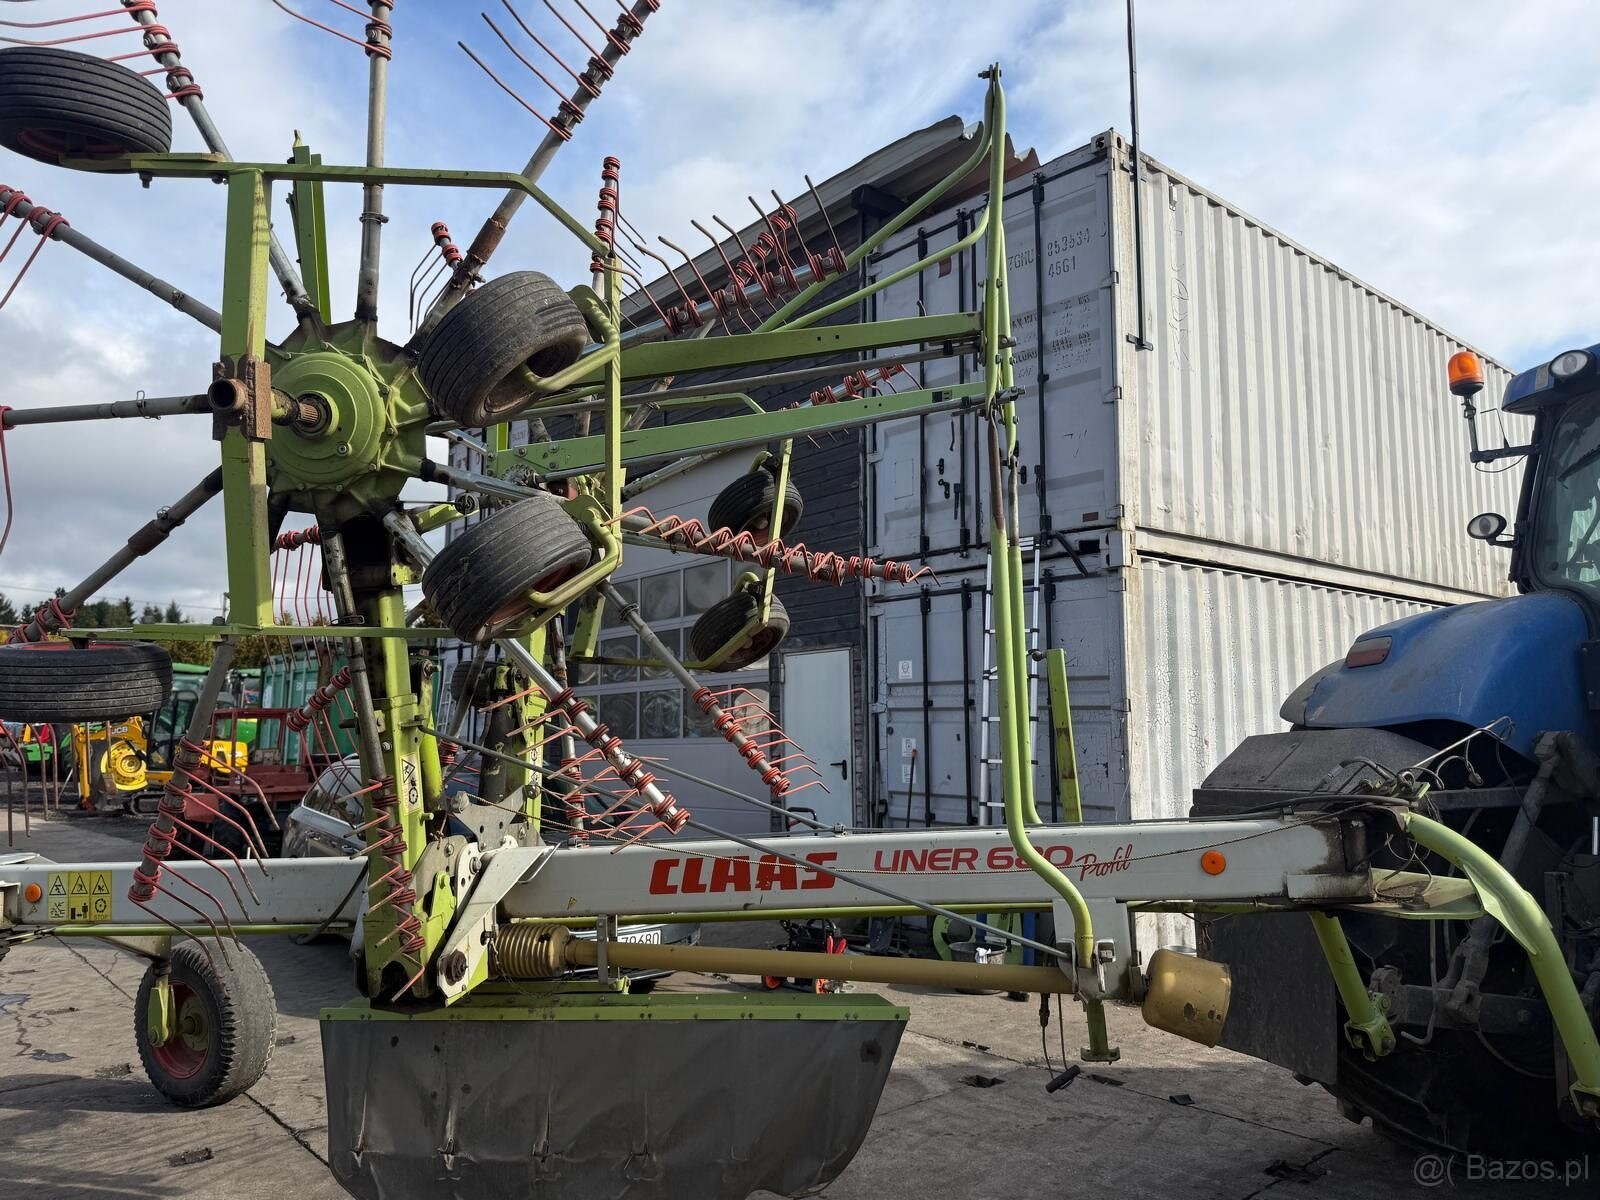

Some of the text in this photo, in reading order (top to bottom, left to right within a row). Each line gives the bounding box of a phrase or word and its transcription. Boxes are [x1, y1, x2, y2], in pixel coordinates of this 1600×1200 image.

[649, 851, 838, 895] CLAAS
[873, 847, 979, 872] LINER
[1075, 843, 1133, 882] Profil
